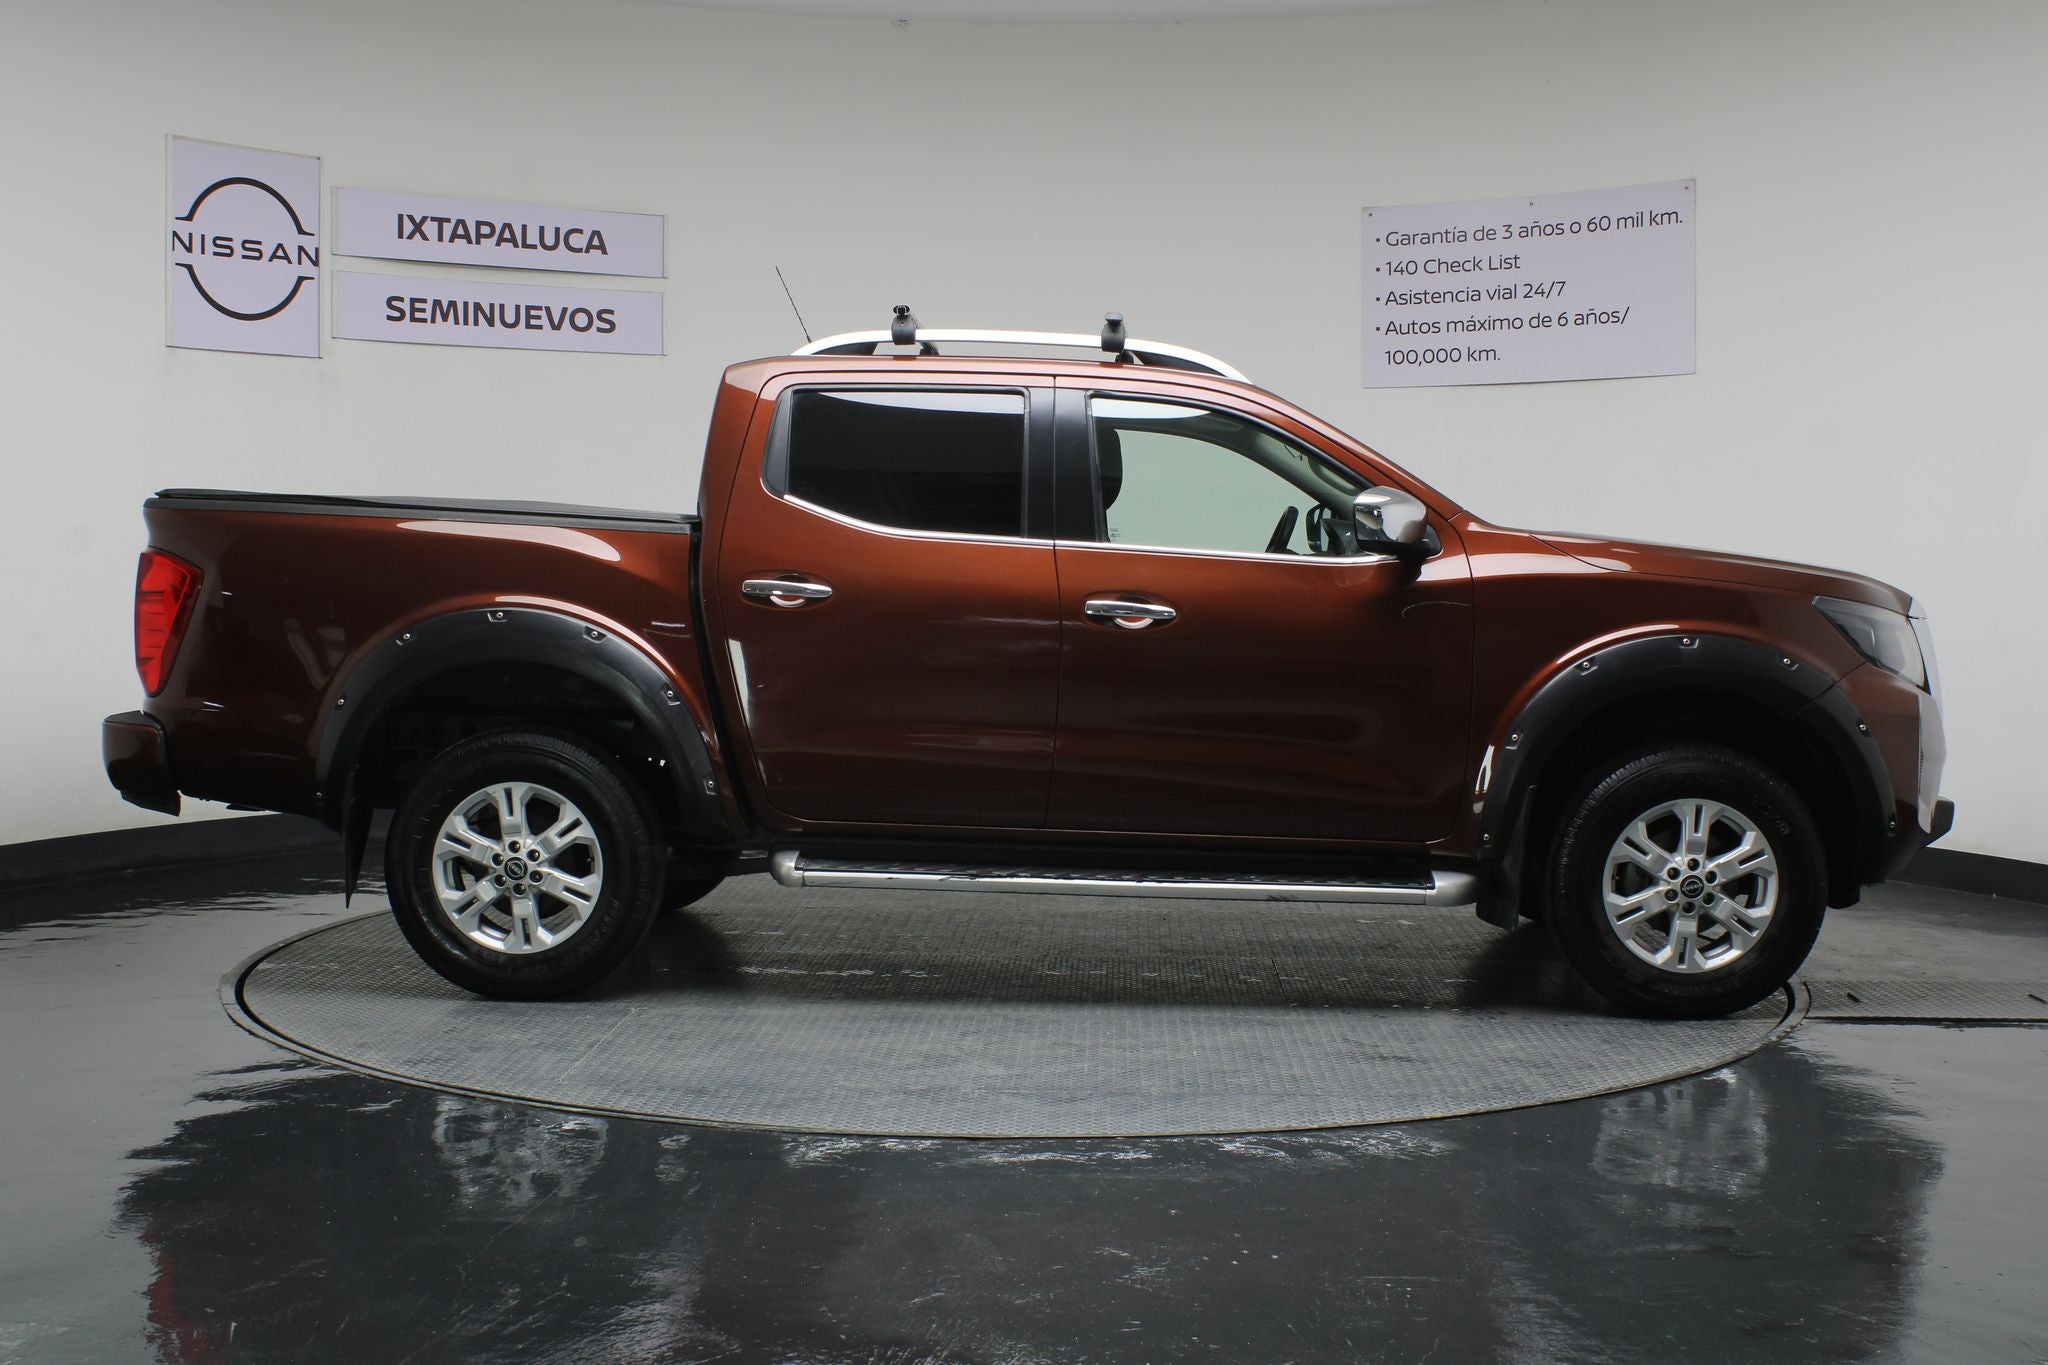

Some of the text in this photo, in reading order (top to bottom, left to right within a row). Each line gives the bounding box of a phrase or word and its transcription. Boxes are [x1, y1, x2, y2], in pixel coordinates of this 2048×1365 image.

[397, 213, 609, 255] IXTAPALUCA
[1385, 209, 1683, 247] Garantía de 3 años o 60 mil km.
[171, 230, 320, 268] NISSAN
[1385, 254, 1521, 276] 140 Check List
[1385, 280, 1566, 306] Asistencia vial 24/7
[385, 295, 617, 334] SEMINUEVOS
[1385, 305, 1630, 336] Autos máximo de 6 años/
[1385, 346, 1501, 366] 100,000 km.
